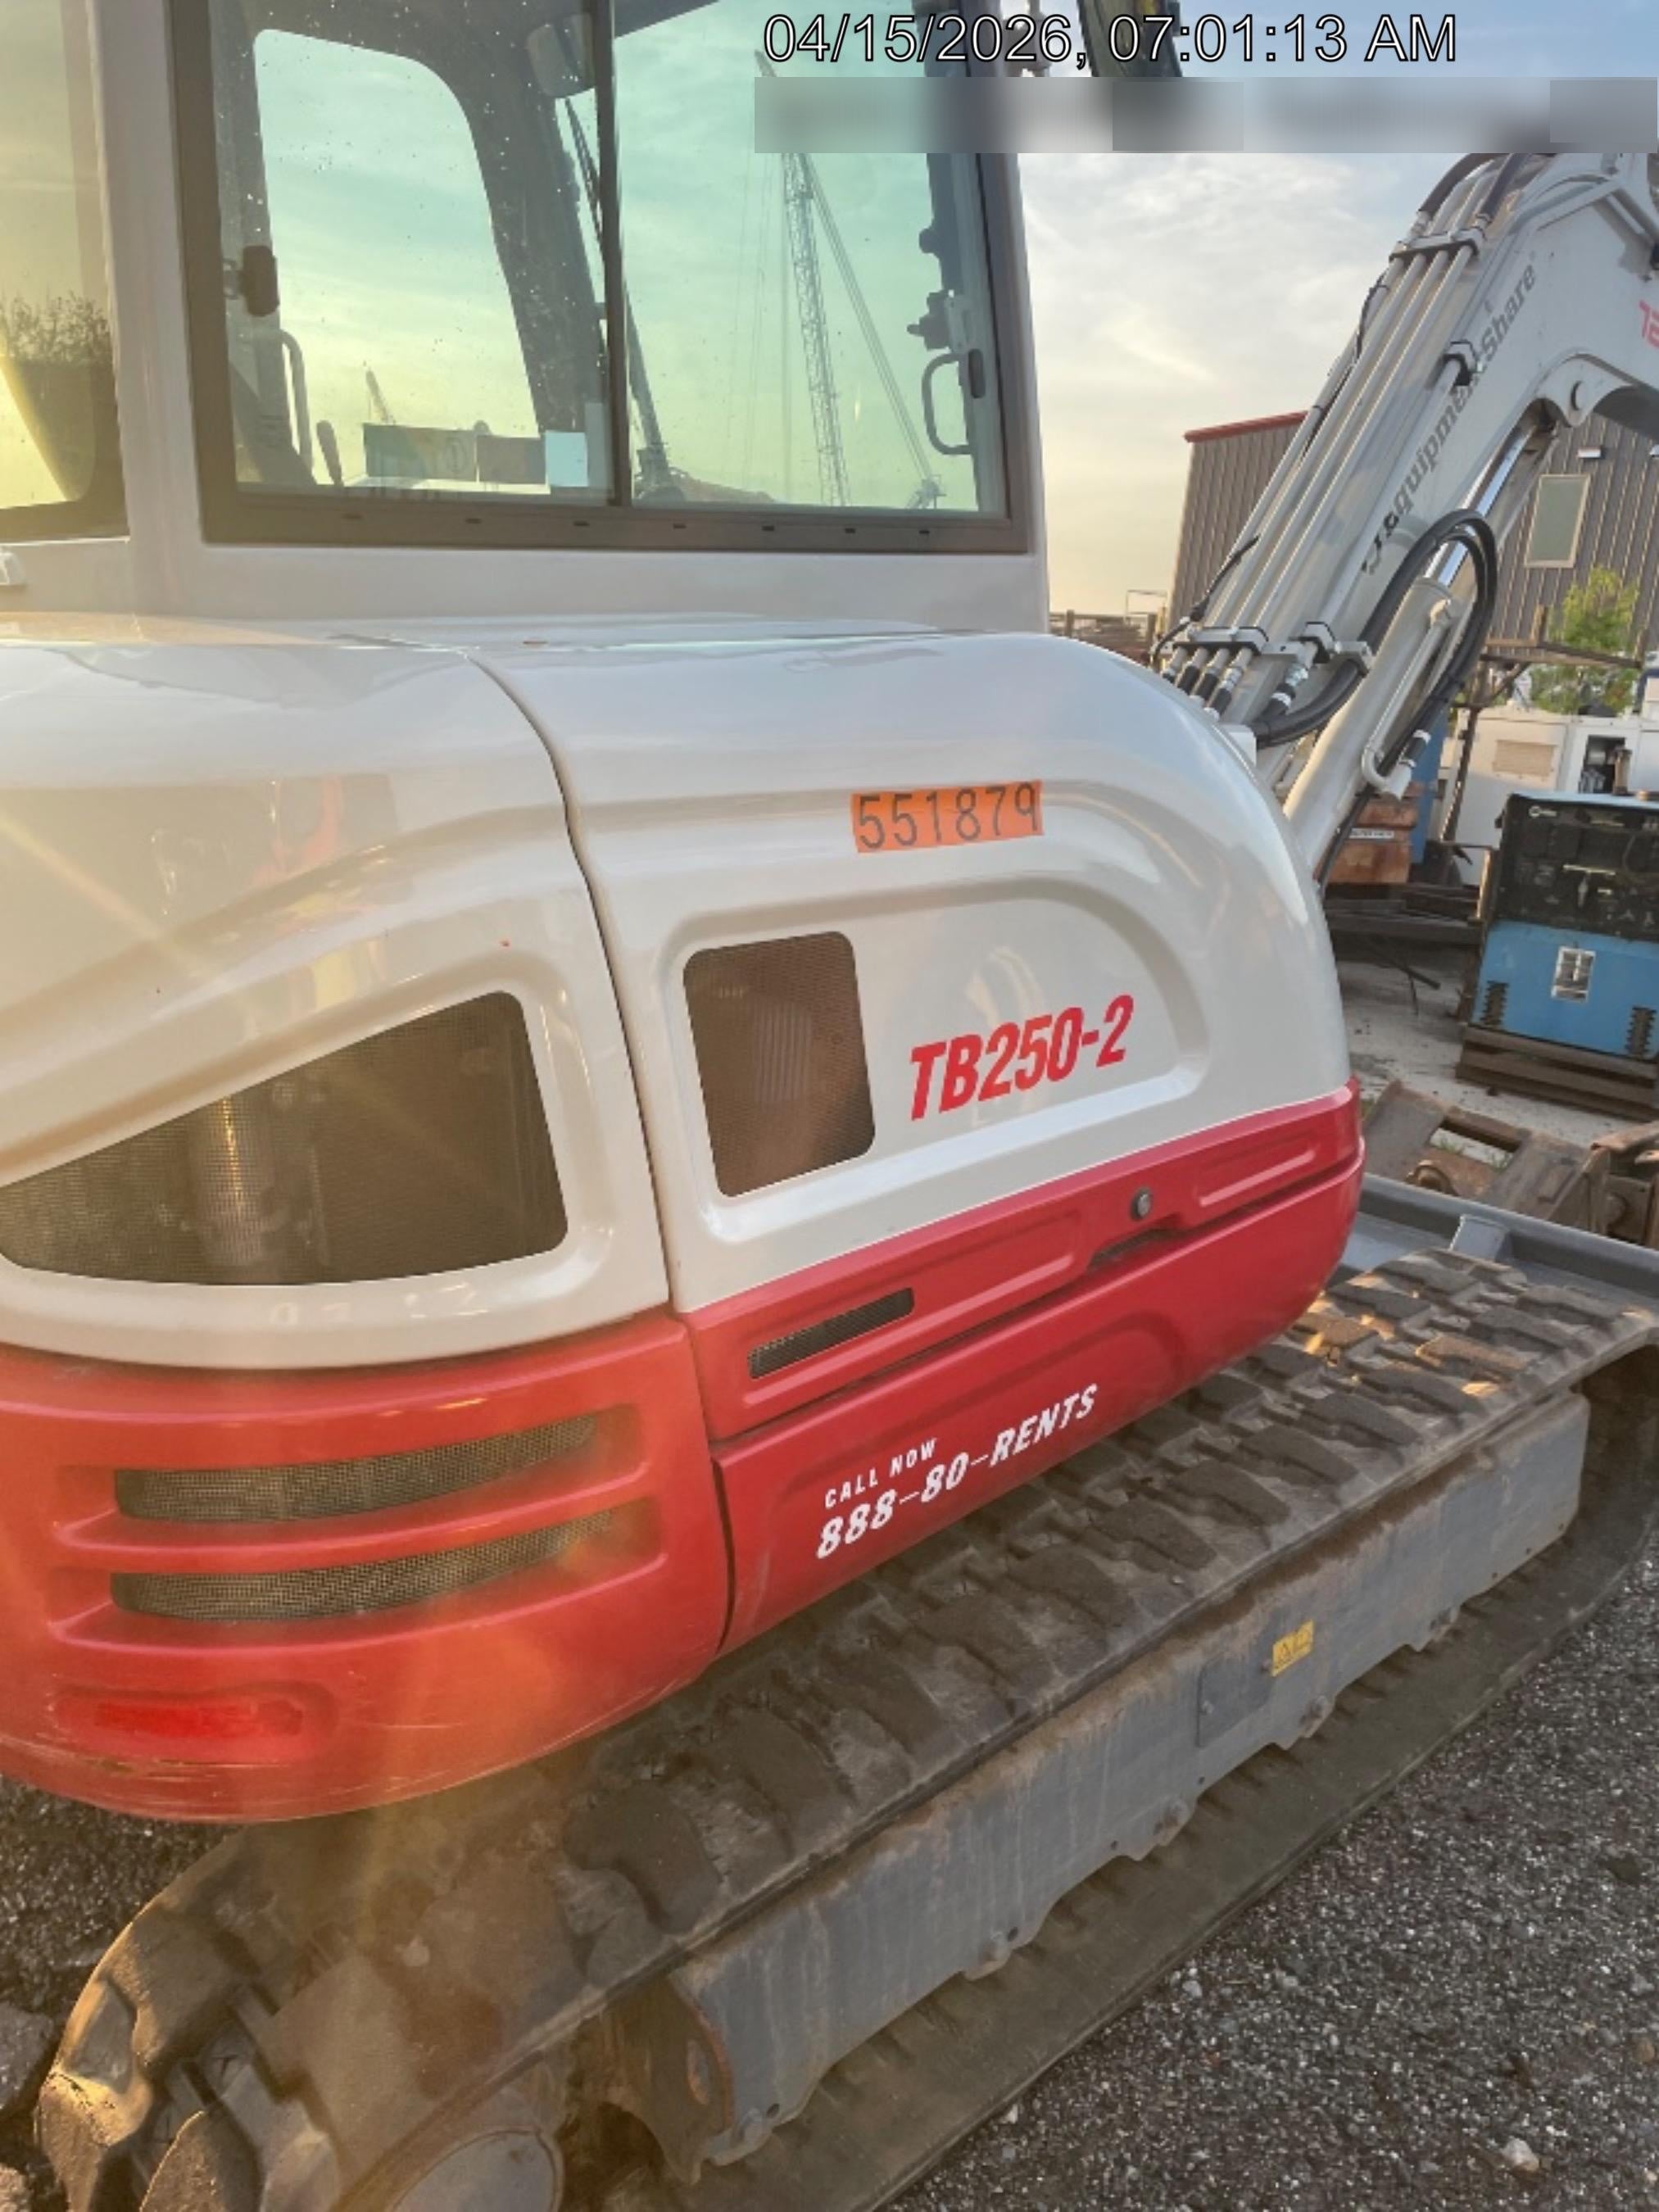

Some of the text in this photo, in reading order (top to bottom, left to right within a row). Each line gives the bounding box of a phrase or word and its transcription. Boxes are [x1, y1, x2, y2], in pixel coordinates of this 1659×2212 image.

[1362, 265, 1536, 574] EquipmeShare
[858, 782, 1039, 850] 551879
[910, 994, 1135, 1122] TB250-2
[817, 1383, 1098, 1559] 888-80-RENTS
[824, 1438, 936, 1509] CALL NOW
